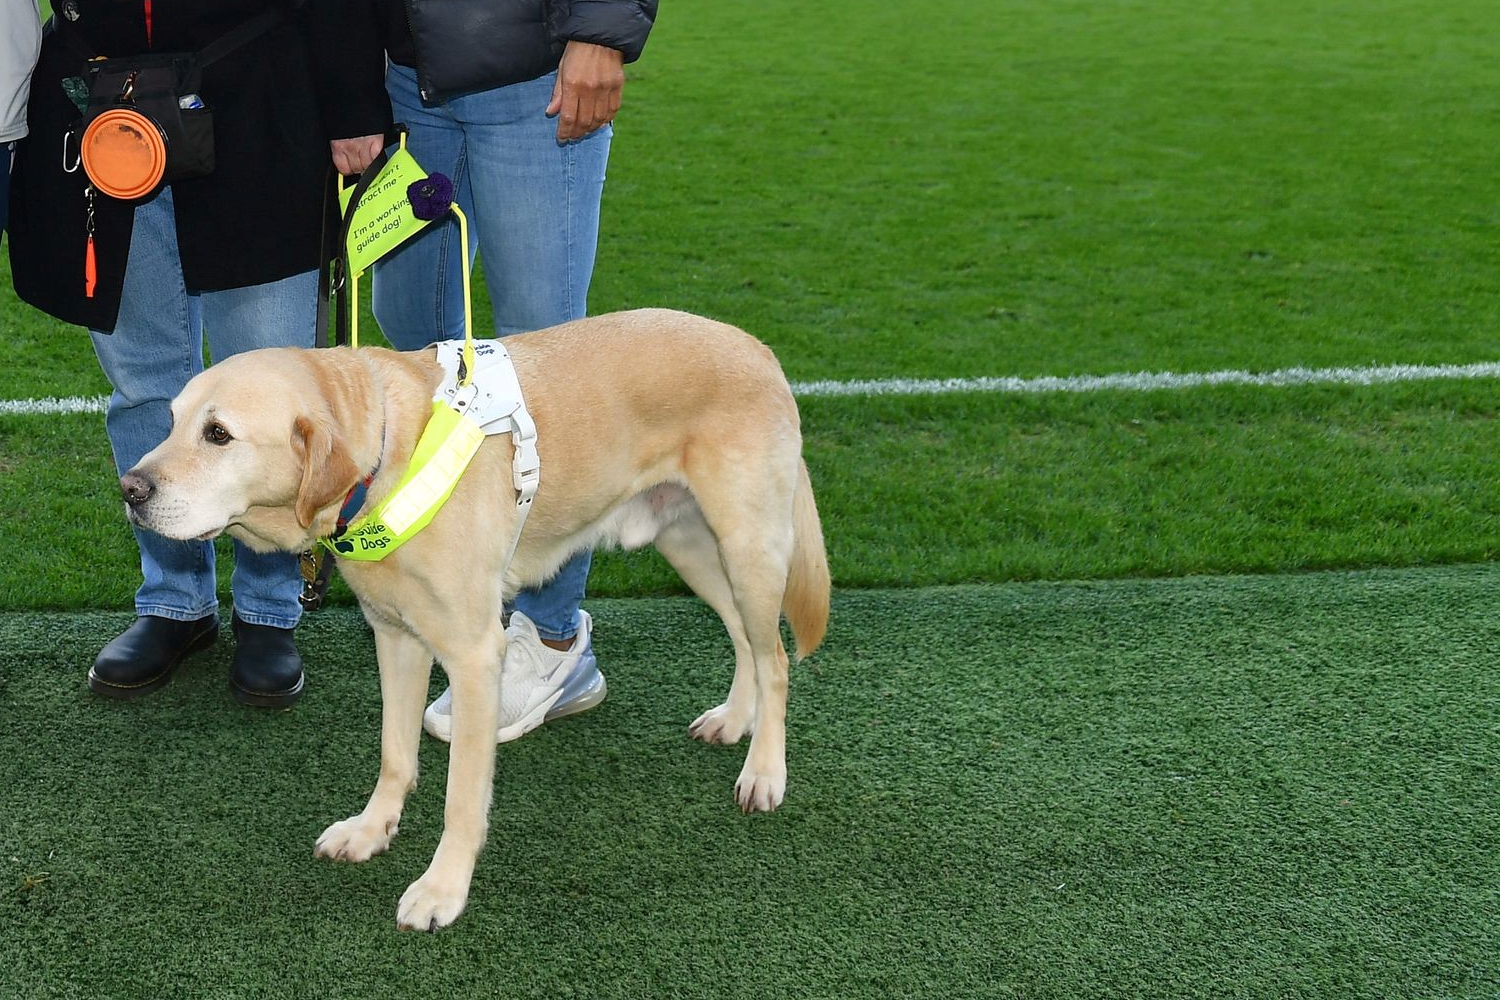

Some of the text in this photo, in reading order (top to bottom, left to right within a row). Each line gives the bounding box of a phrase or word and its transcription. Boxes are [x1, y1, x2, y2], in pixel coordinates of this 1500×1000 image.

[369, 220, 375, 229] a
[376, 197, 411, 224] working
[356, 215, 403, 253] guide dog!
[361, 536, 391, 550] Dogs
